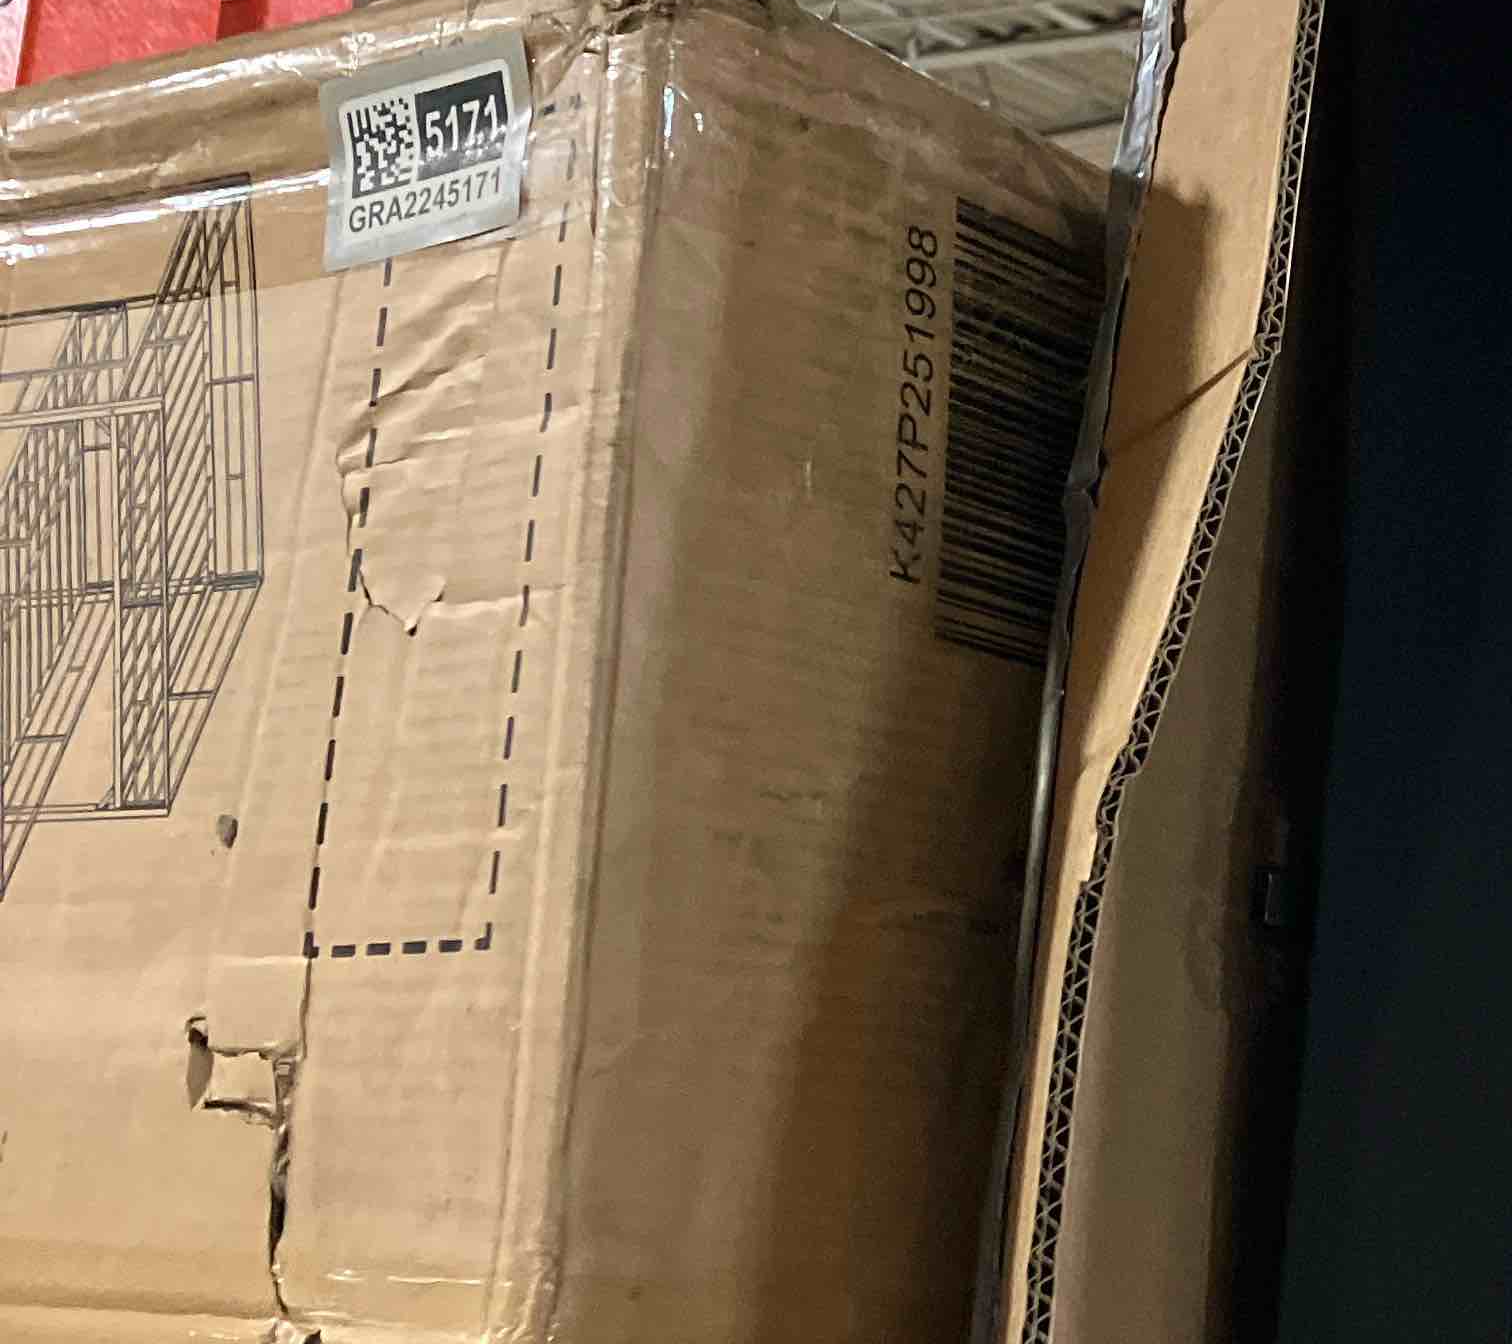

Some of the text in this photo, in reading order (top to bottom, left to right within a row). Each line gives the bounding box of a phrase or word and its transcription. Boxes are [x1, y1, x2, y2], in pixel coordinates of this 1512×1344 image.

[424, 94, 500, 158] 5171
[348, 167, 501, 233] GRA2245171
[889, 225, 938, 585] K427P251998
